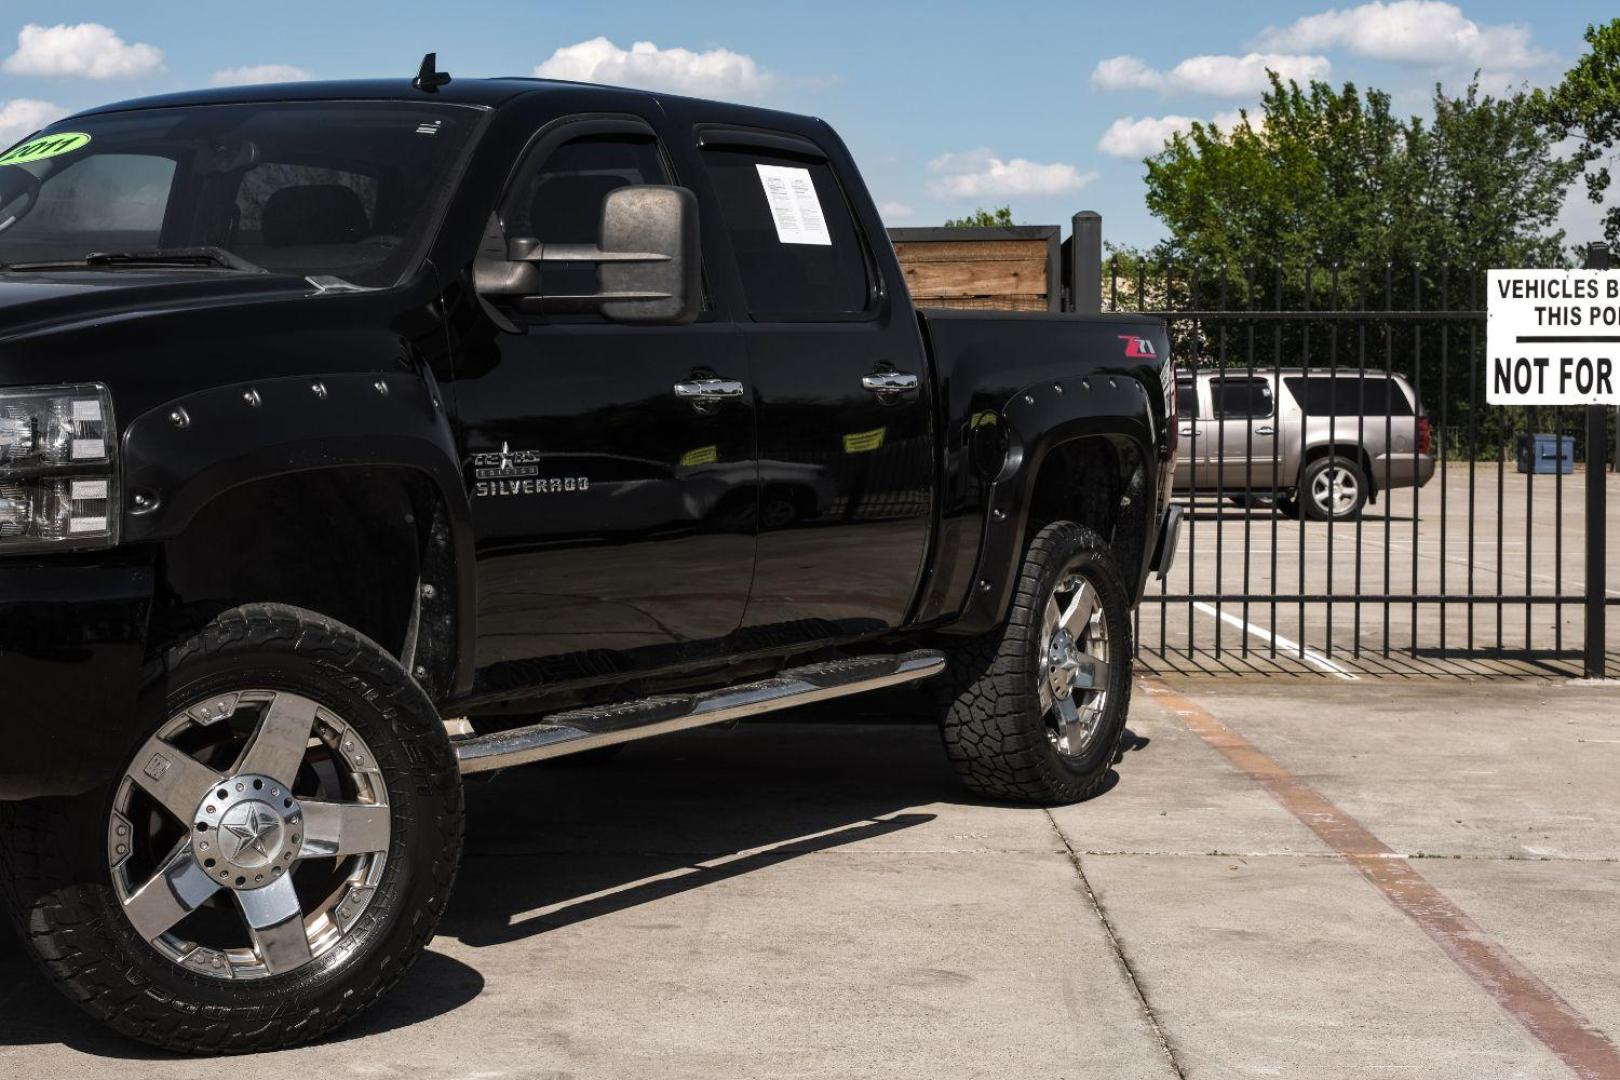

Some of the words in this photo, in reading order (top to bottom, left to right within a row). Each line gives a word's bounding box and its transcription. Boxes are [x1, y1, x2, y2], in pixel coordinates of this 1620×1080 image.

[1497, 279, 1599, 299] VEHICLES
[1534, 306, 1582, 326] THIS
[1590, 306, 1620, 326] PO
[1117, 335, 1157, 358] Z71
[1494, 357, 1549, 395] NOT
[1559, 357, 1613, 395] FOR
[476, 477, 589, 497] SILVERADO
